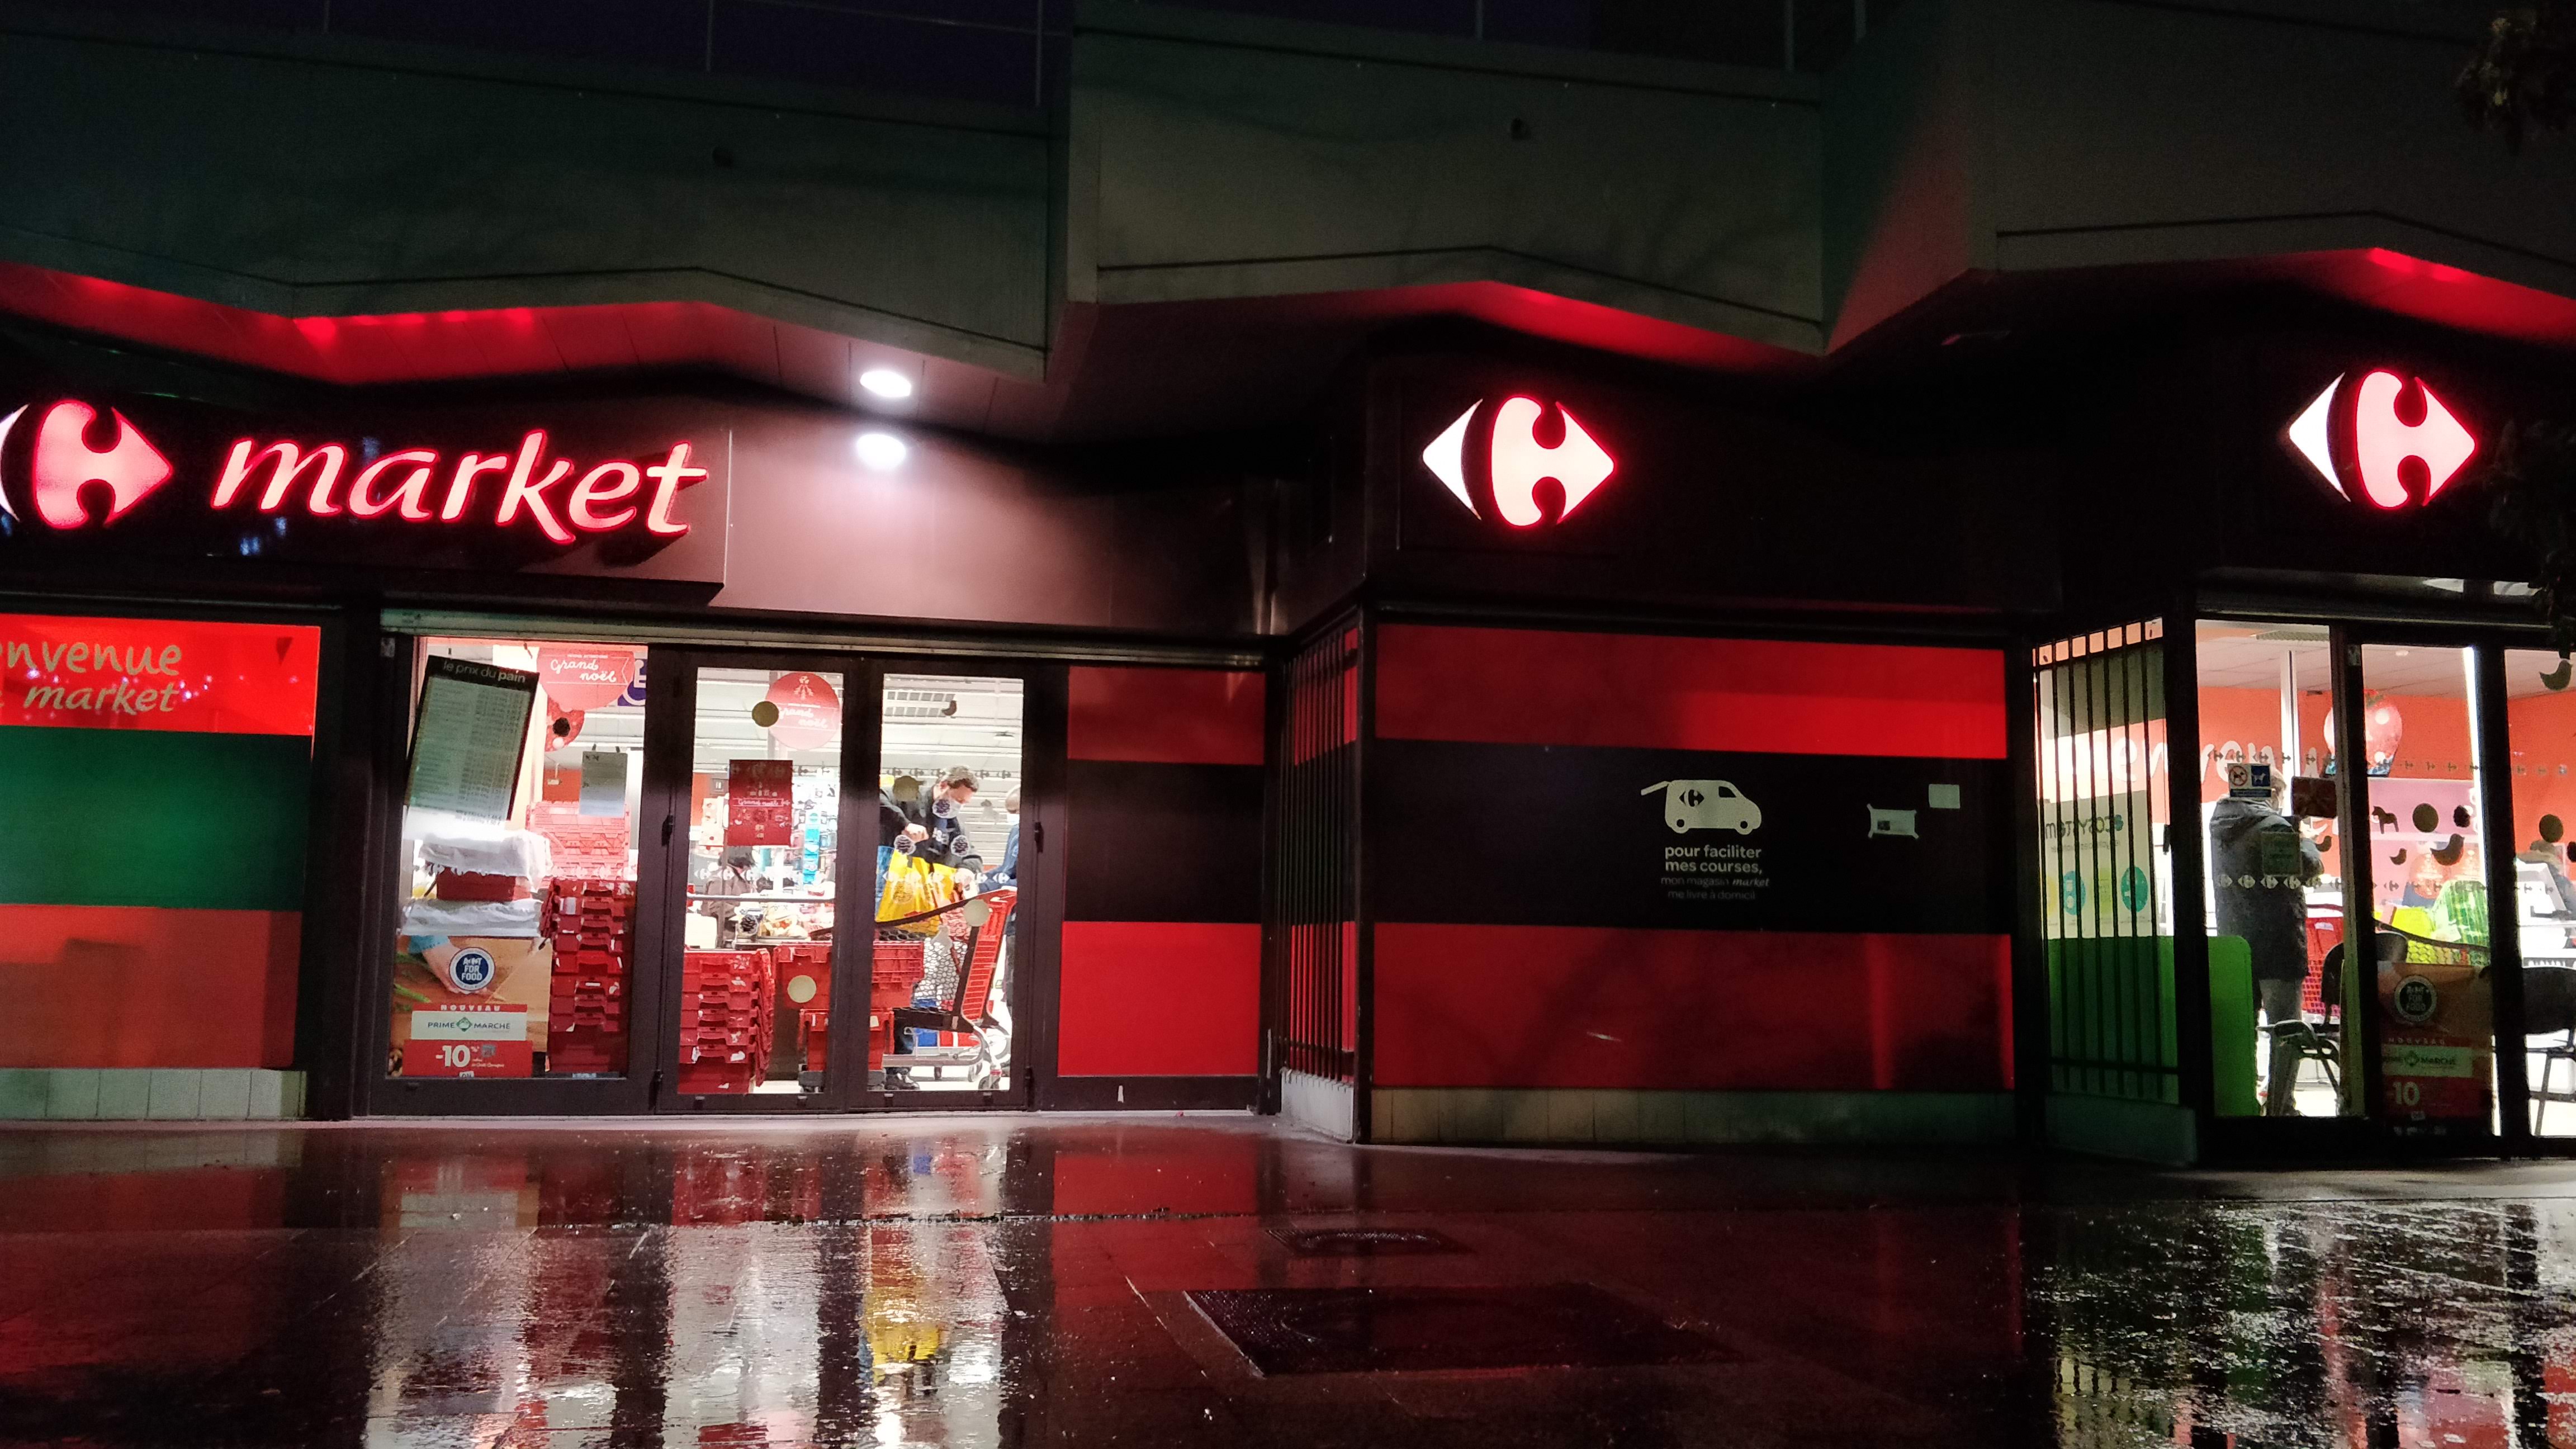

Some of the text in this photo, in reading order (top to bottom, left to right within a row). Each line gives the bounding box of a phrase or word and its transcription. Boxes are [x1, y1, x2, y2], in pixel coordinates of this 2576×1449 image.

[211, 429, 708, 543] market
[0, 641, 182, 676] nvenue
[443, 661, 526, 683] le prix du pain
[550, 658, 599, 675] Grand
[579, 670, 617, 683] noël
[23, 682, 179, 716] market
[1665, 845, 1762, 859] pour faciliter
[1665, 861, 1763, 875] mes courses,
[1661, 877, 1685, 886] mon
[1732, 877, 1770, 887] market
[1668, 891, 1685, 899] me
[1686, 890, 1708, 899] livre
[464, 965, 480, 973] FOR
